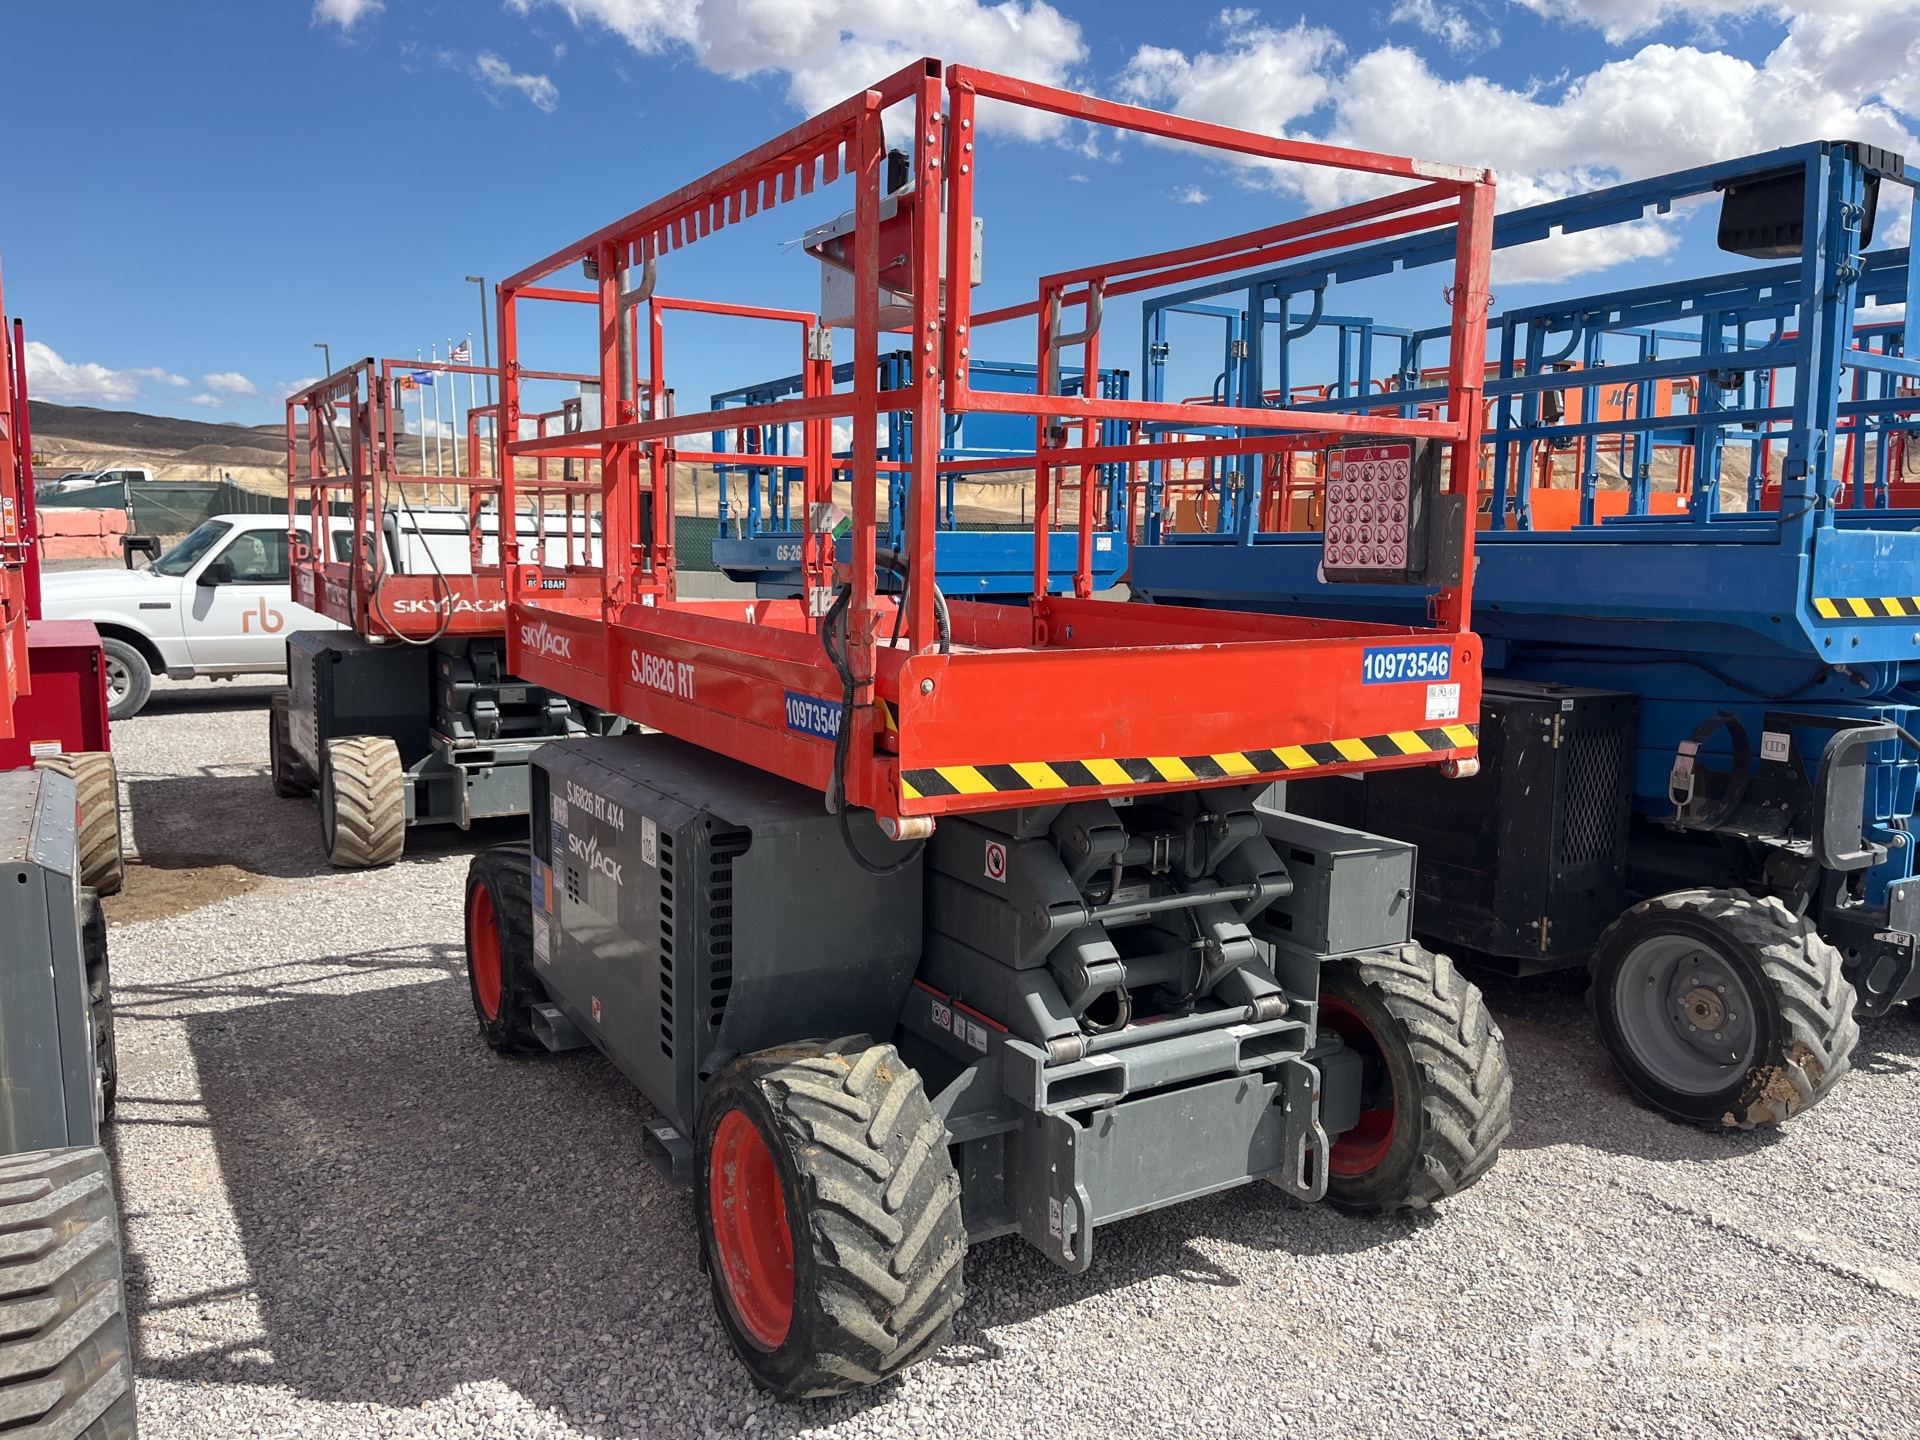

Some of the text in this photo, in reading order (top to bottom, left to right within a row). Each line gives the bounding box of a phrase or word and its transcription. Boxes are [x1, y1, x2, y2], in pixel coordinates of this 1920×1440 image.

[242, 596, 284, 634] rb
[521, 620, 571, 659] SKYJACK
[631, 649, 695, 700] SJ6826 RT
[1364, 651, 1449, 680] 10973546
[566, 780, 625, 832] SJ6826 RT 4X4
[568, 833, 624, 887] SKYJACK
